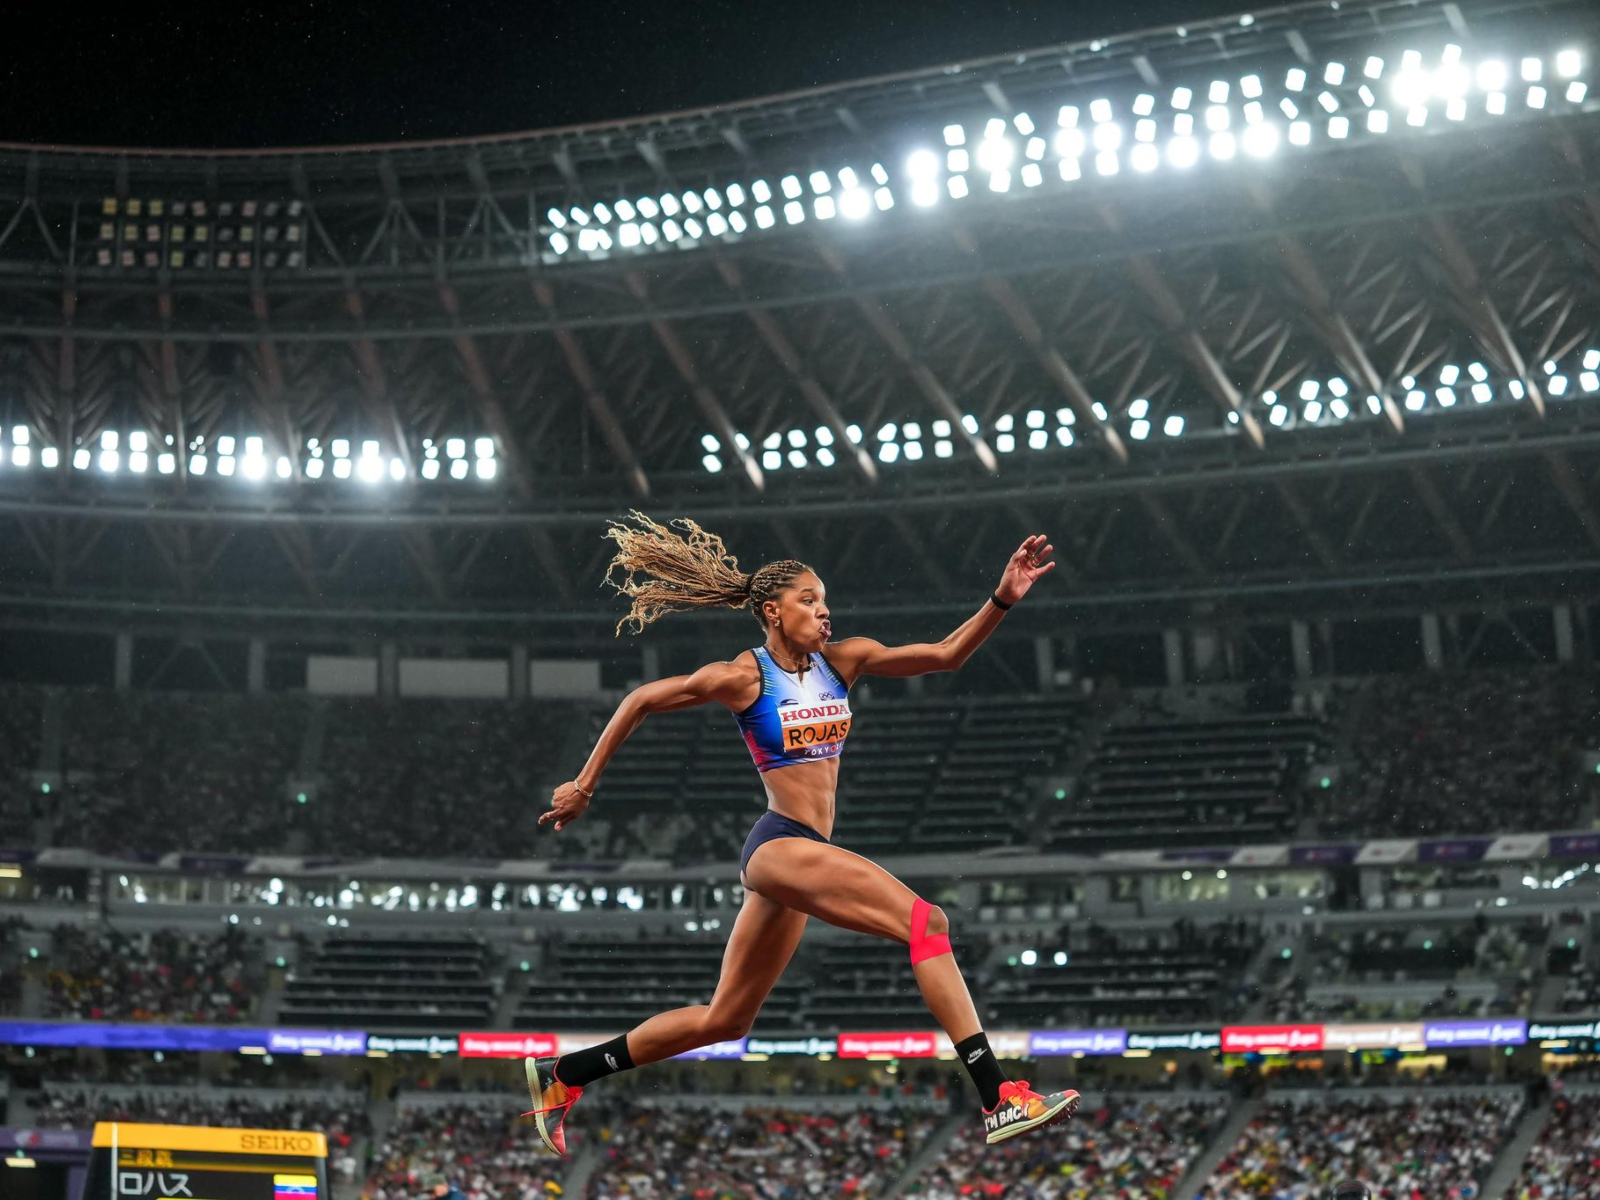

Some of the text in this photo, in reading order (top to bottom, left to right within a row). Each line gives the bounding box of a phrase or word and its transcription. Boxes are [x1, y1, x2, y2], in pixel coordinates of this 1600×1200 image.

[780, 704, 849, 723] HONDA
[788, 721, 848, 746] ROJAS
[984, 1113, 998, 1132] I'M
[240, 1133, 312, 1151] SEIKO
[119, 1171, 193, 1197] ロハス
